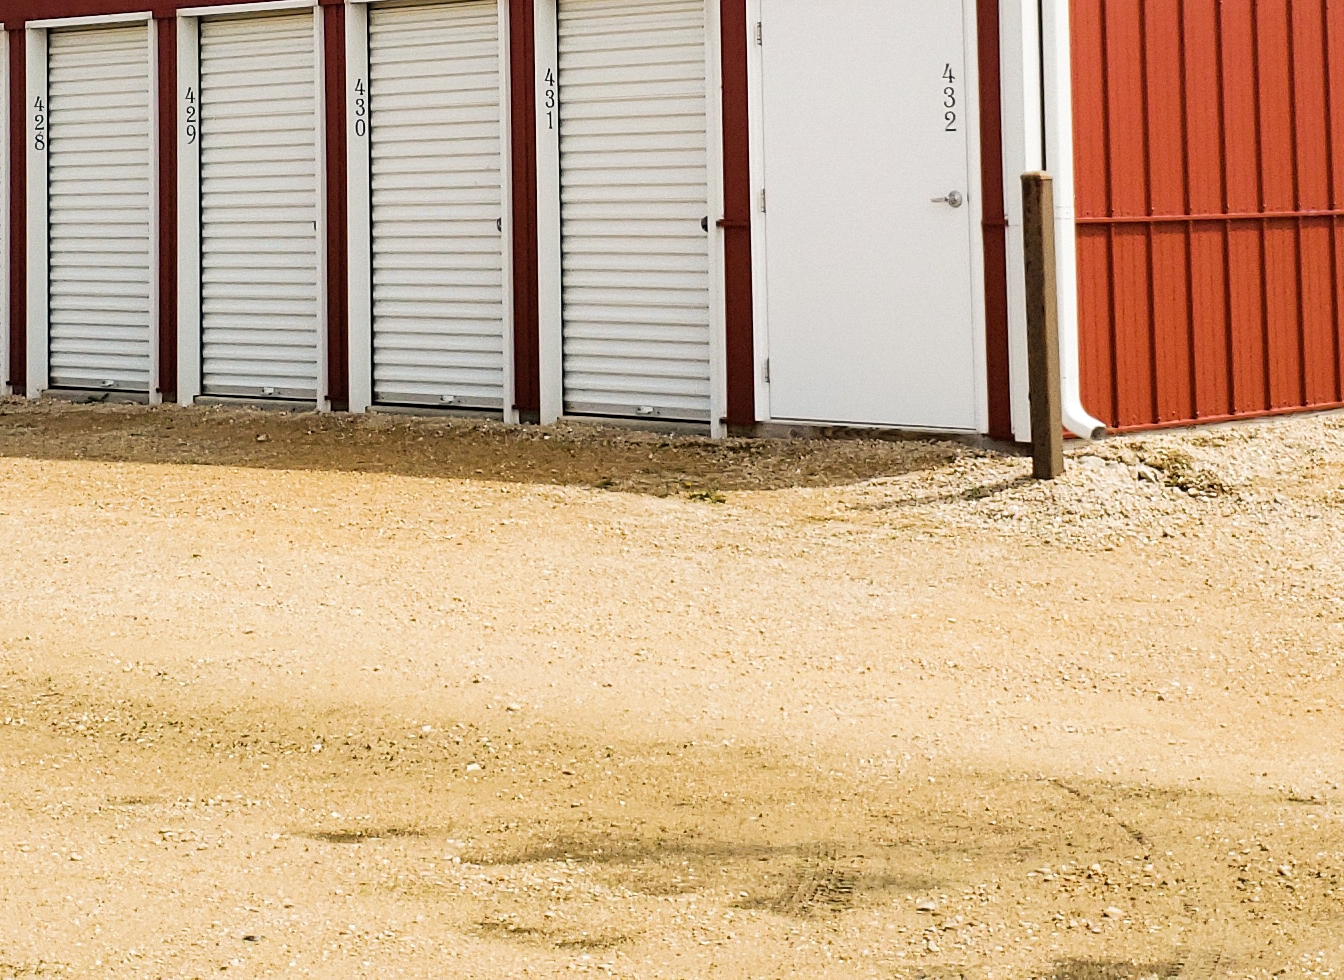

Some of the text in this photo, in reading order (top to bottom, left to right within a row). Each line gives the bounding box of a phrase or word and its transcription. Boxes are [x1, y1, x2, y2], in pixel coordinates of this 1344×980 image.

[33, 95, 45, 151] 428
[185, 86, 197, 145] 429
[354, 78, 366, 137] 430
[544, 67, 556, 130] 431
[941, 63, 957, 132] 432
